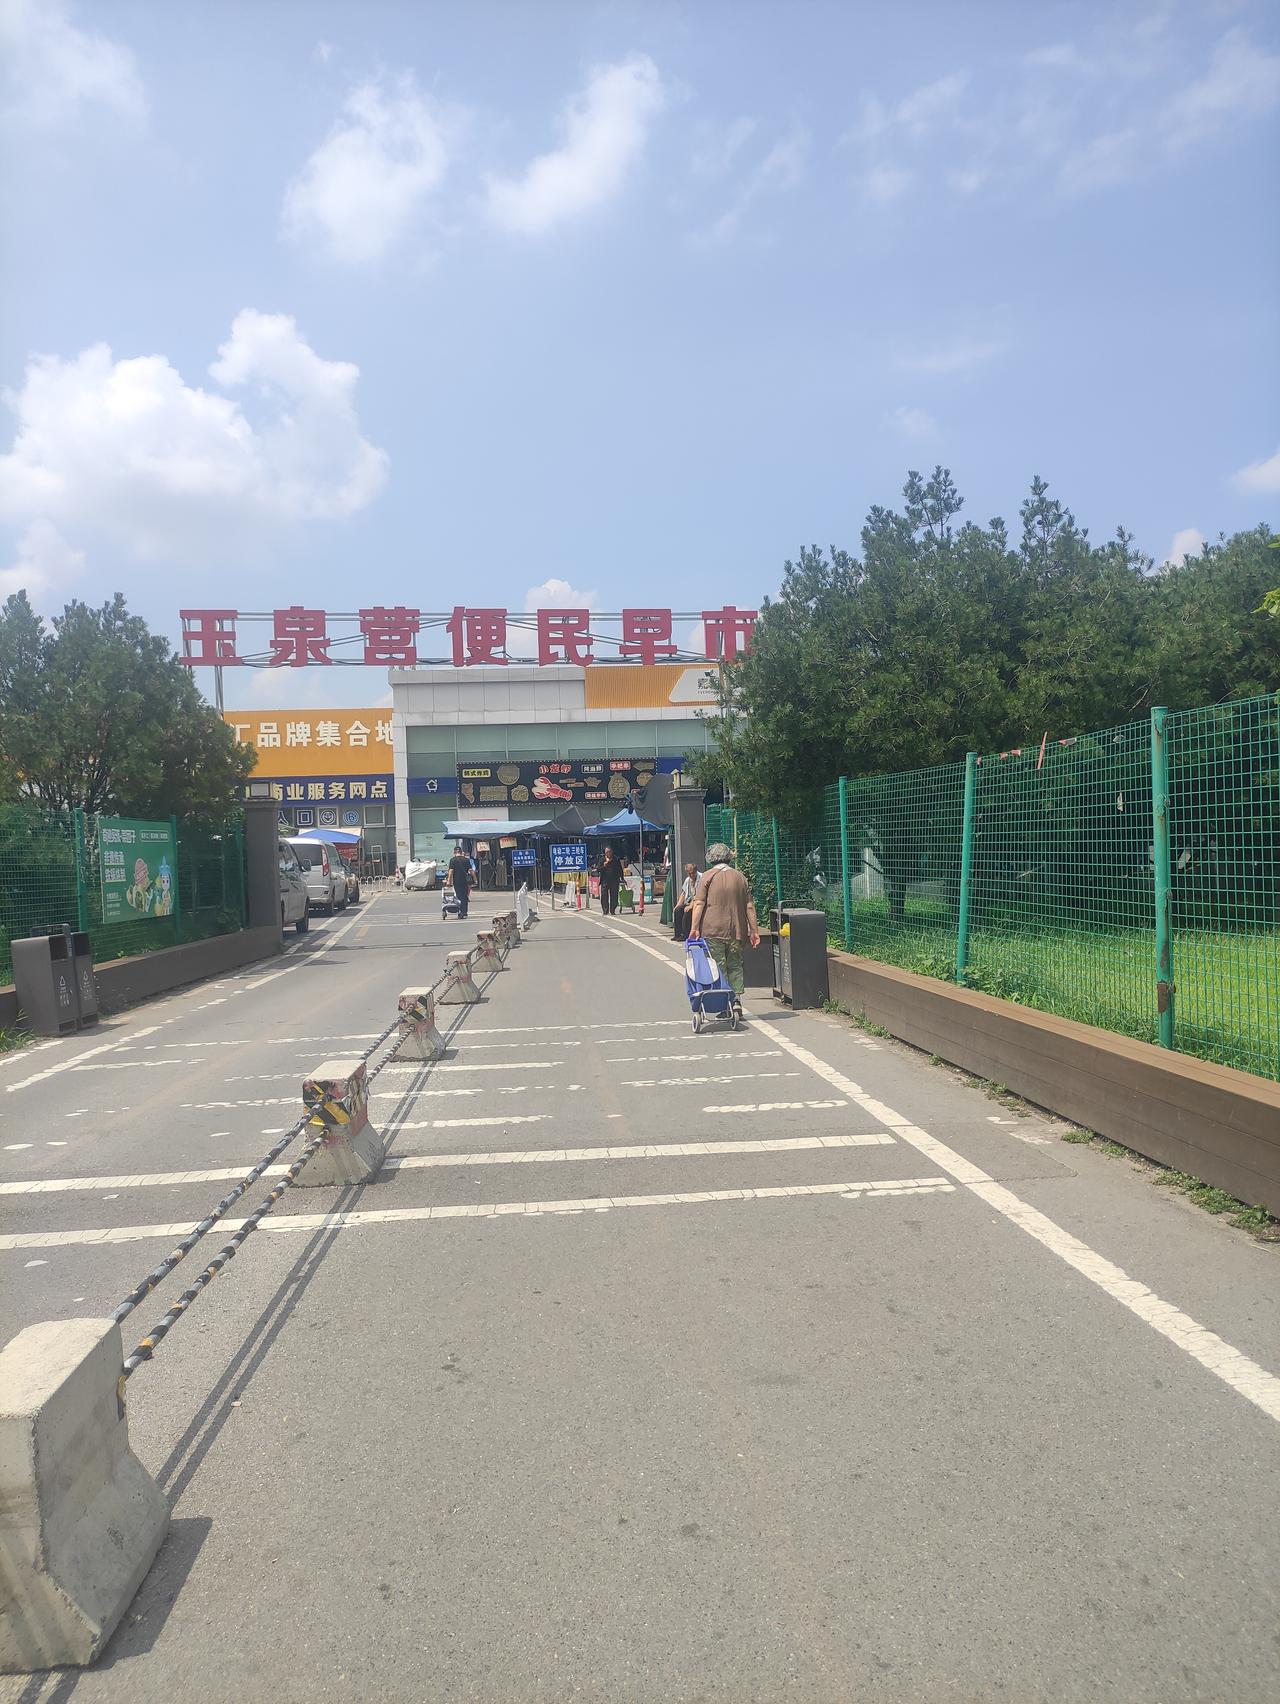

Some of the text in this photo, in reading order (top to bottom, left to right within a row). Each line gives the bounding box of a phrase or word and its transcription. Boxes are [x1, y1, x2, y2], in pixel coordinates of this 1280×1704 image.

[179, 605, 758, 668] 玉泉营便民早市
[245, 781, 388, 801] 商业服务网点
[554, 856, 584, 866] 停放区
